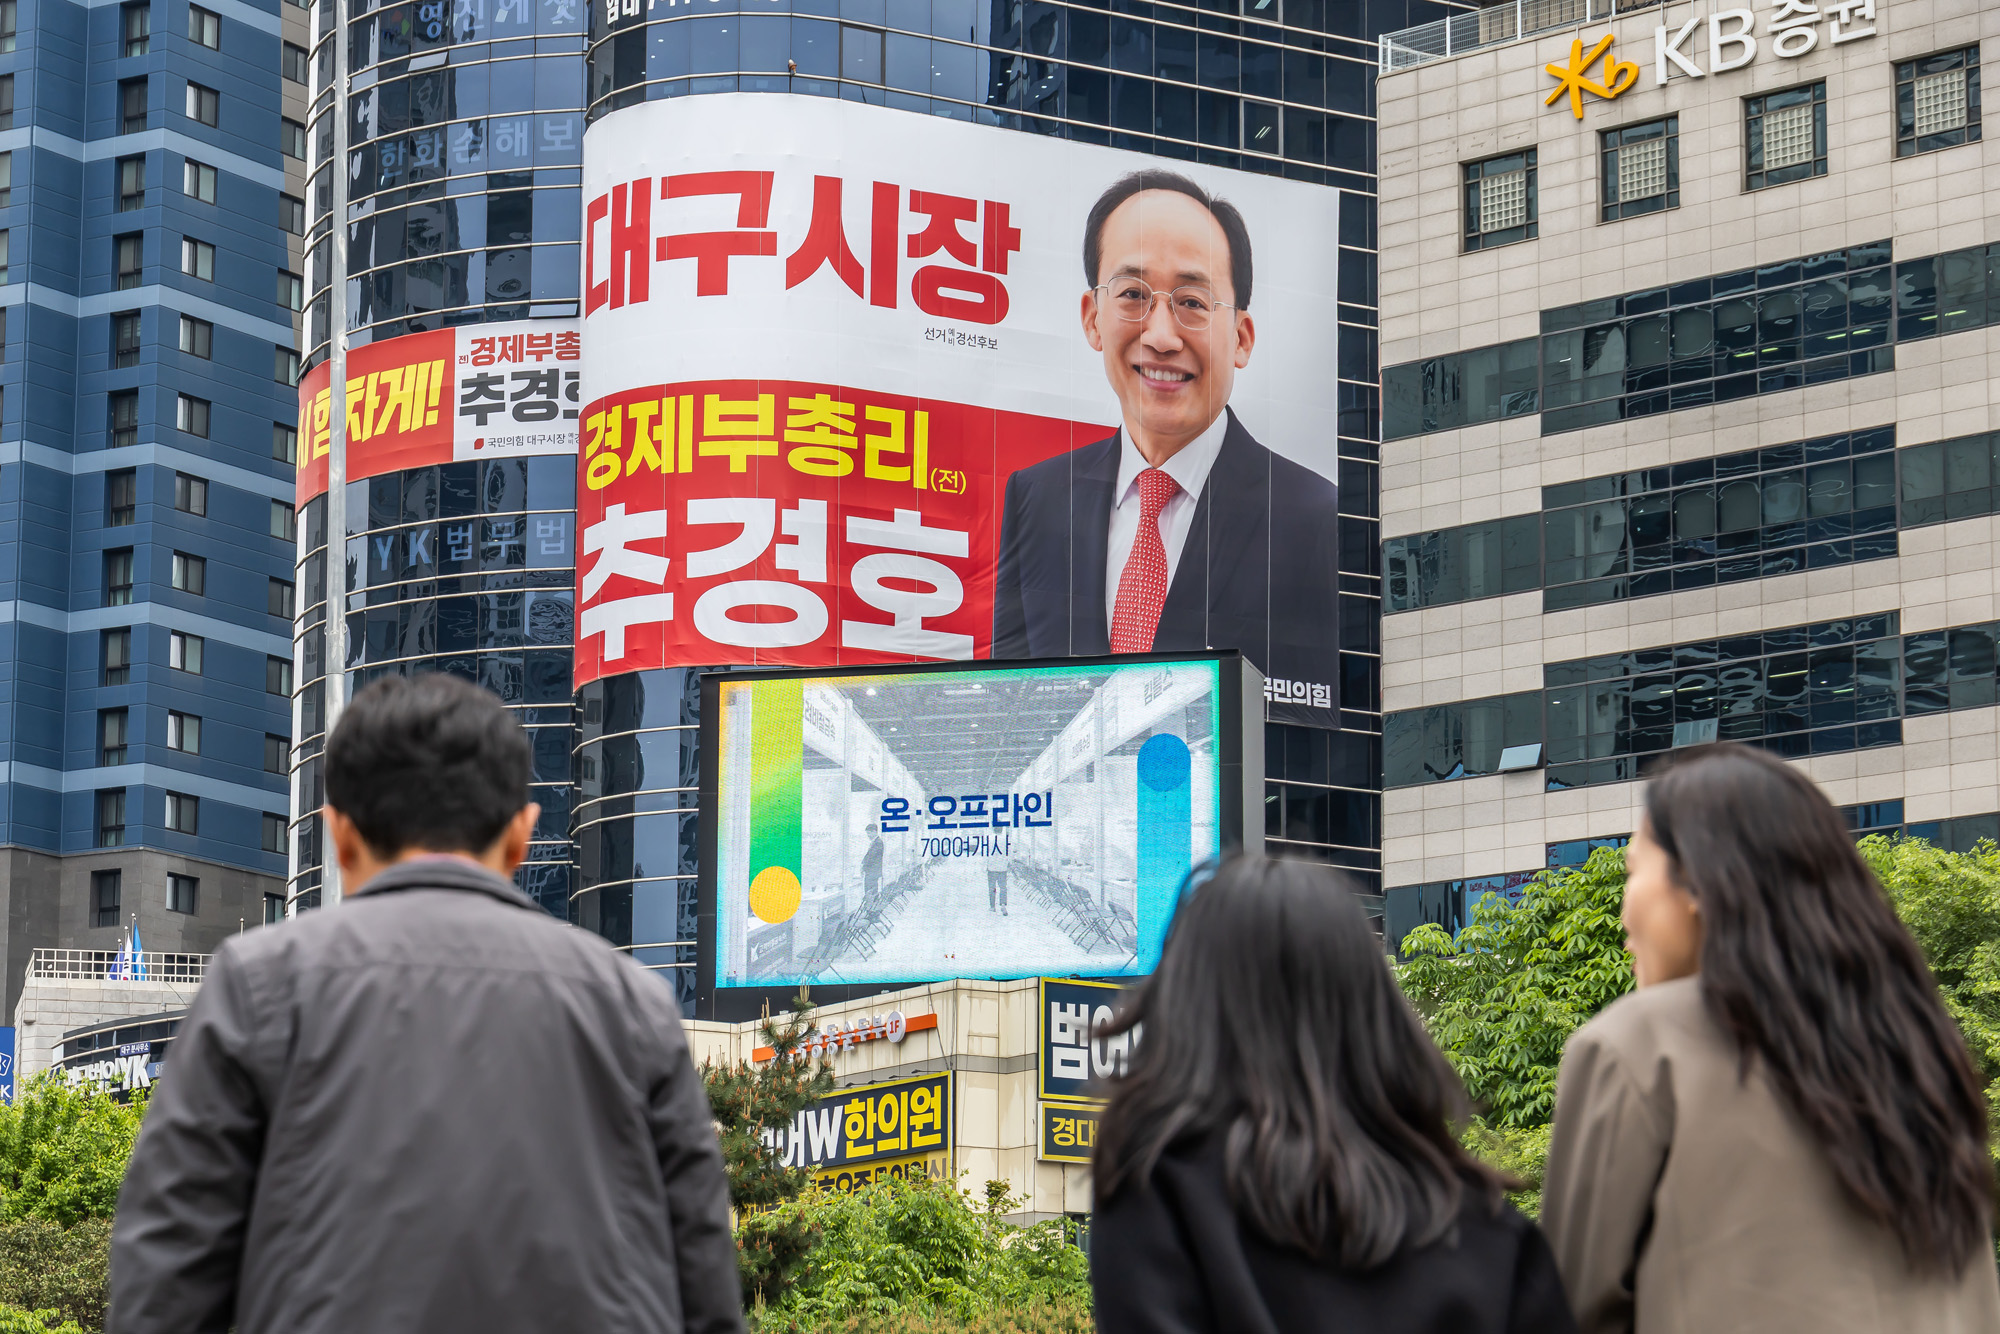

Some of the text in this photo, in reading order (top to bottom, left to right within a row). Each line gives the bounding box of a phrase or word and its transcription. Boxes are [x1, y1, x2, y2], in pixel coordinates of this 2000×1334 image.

[1655, 0, 1877, 86] KB증권
[585, 170, 1021, 326] 대구시장
[487, 436, 524, 448] 국민의힘
[527, 434, 566, 446] 대구시장
[581, 497, 974, 662] 추경호
[921, 834, 1012, 858] 7000여개사
[889, 1019, 900, 1034] 1F
